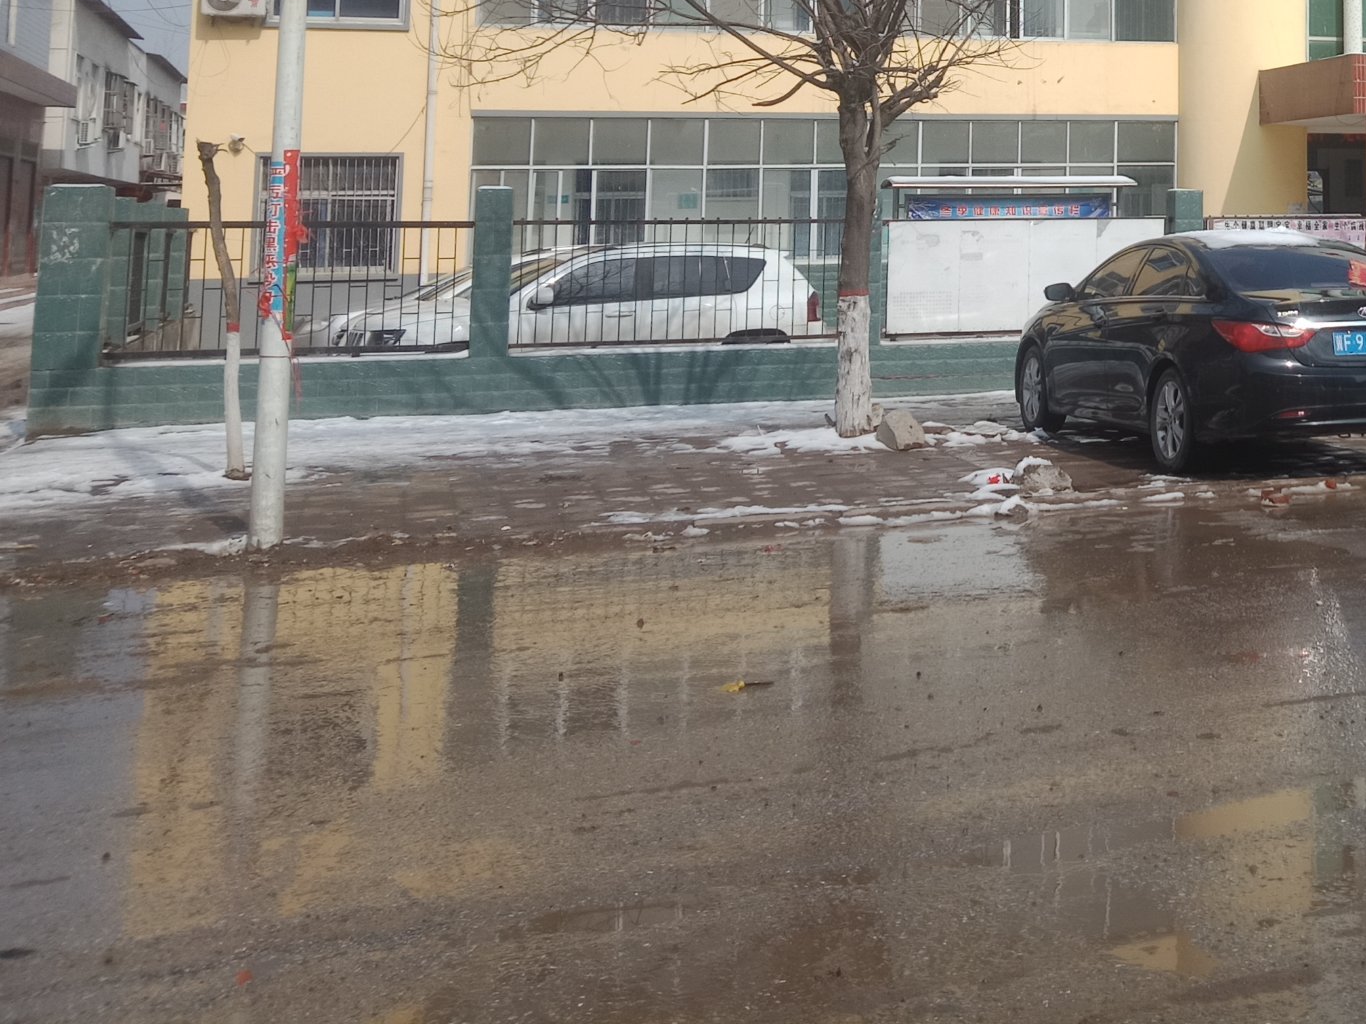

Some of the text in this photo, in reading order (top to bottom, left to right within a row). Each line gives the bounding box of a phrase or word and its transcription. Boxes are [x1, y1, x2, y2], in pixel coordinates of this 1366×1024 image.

[939, 204, 1081, 217] 冬季健康知识宣传栏
